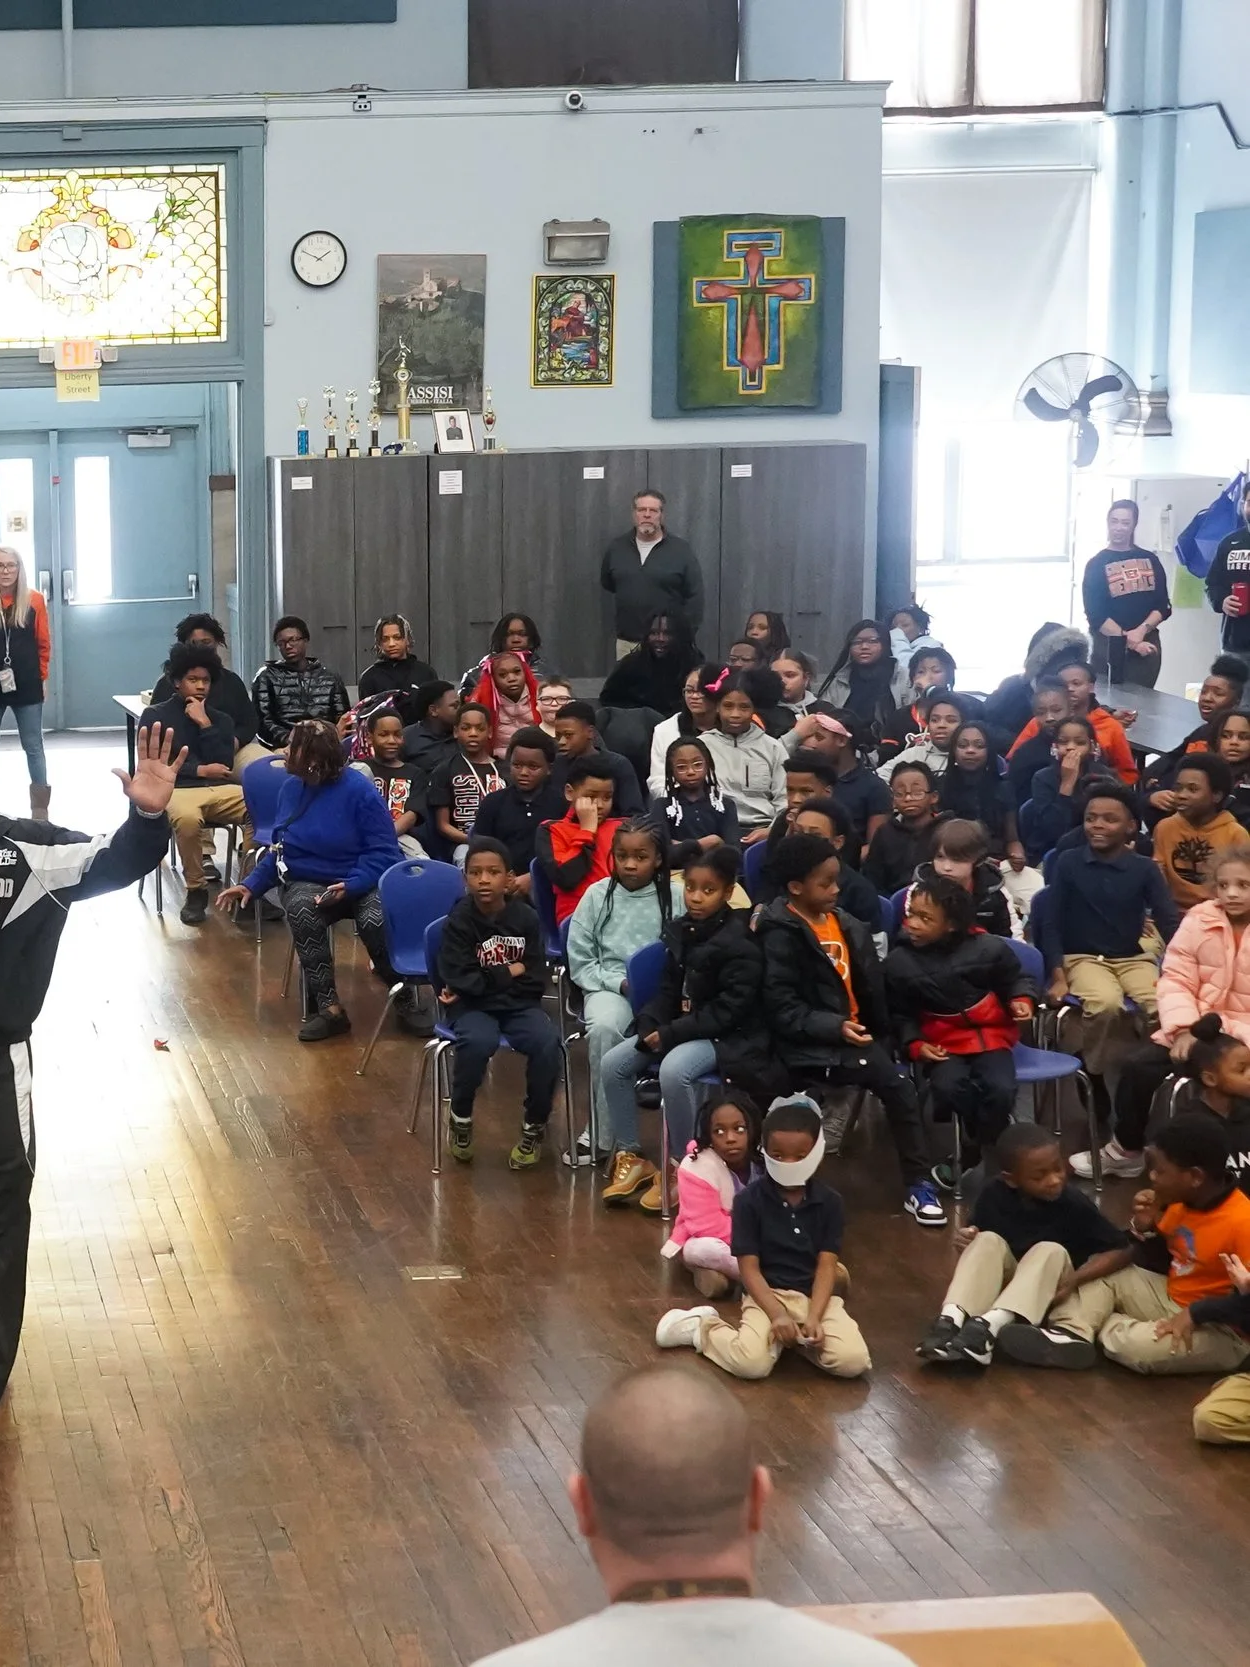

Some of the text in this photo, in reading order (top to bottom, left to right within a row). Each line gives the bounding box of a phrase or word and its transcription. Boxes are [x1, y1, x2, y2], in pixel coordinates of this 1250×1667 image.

[62, 341, 95, 366] EXIT
[64, 372, 92, 381] Liberty
[66, 386, 91, 394] Street
[407, 386, 454, 399] ASSISI
